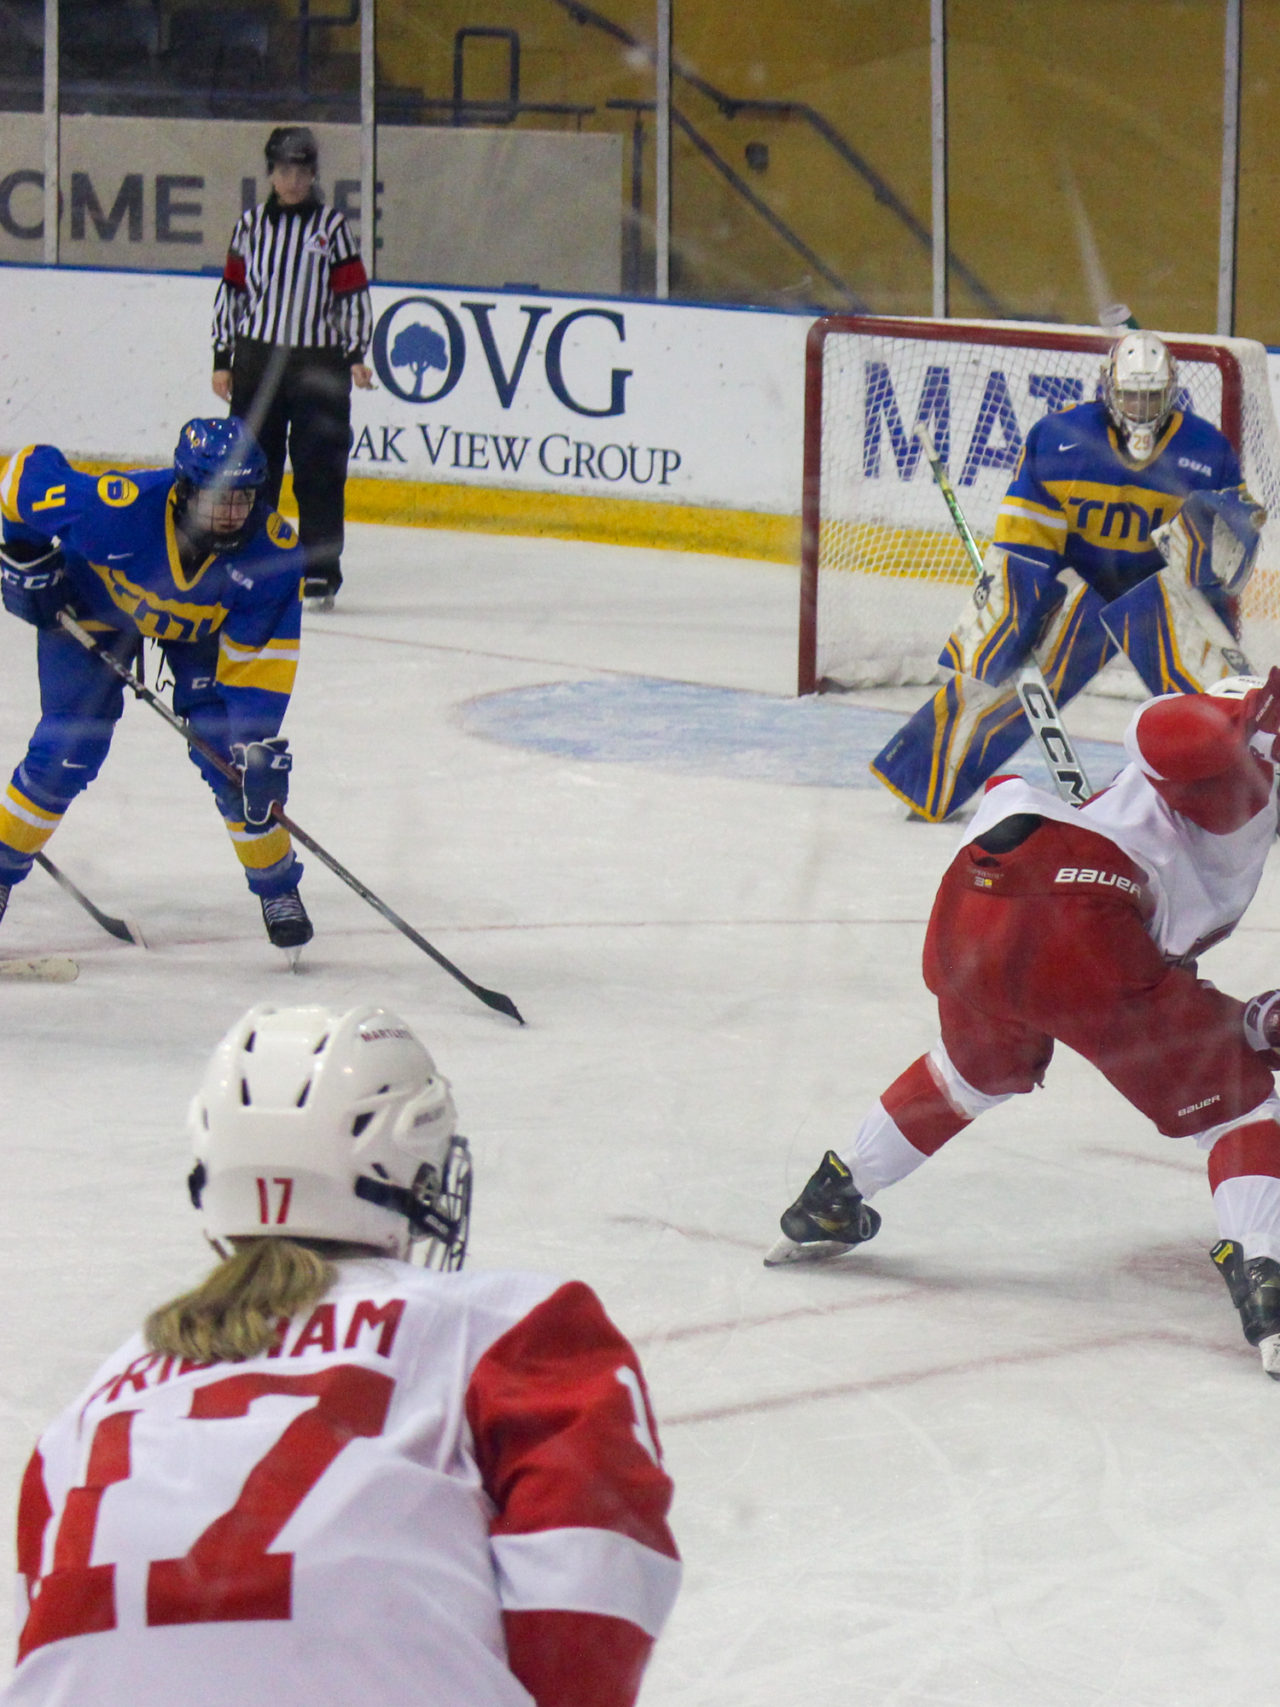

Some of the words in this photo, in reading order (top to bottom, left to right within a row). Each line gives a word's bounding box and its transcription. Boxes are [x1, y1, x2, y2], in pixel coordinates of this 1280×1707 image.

[372, 296, 633, 418] OVG
[350, 424, 409, 463] AK
[416, 423, 532, 472] VIEW
[538, 433, 683, 486] GROUP
[1054, 867, 1142, 898] BAUER
[256, 1177, 294, 1224] 17
[15, 1364, 396, 1667] 17
